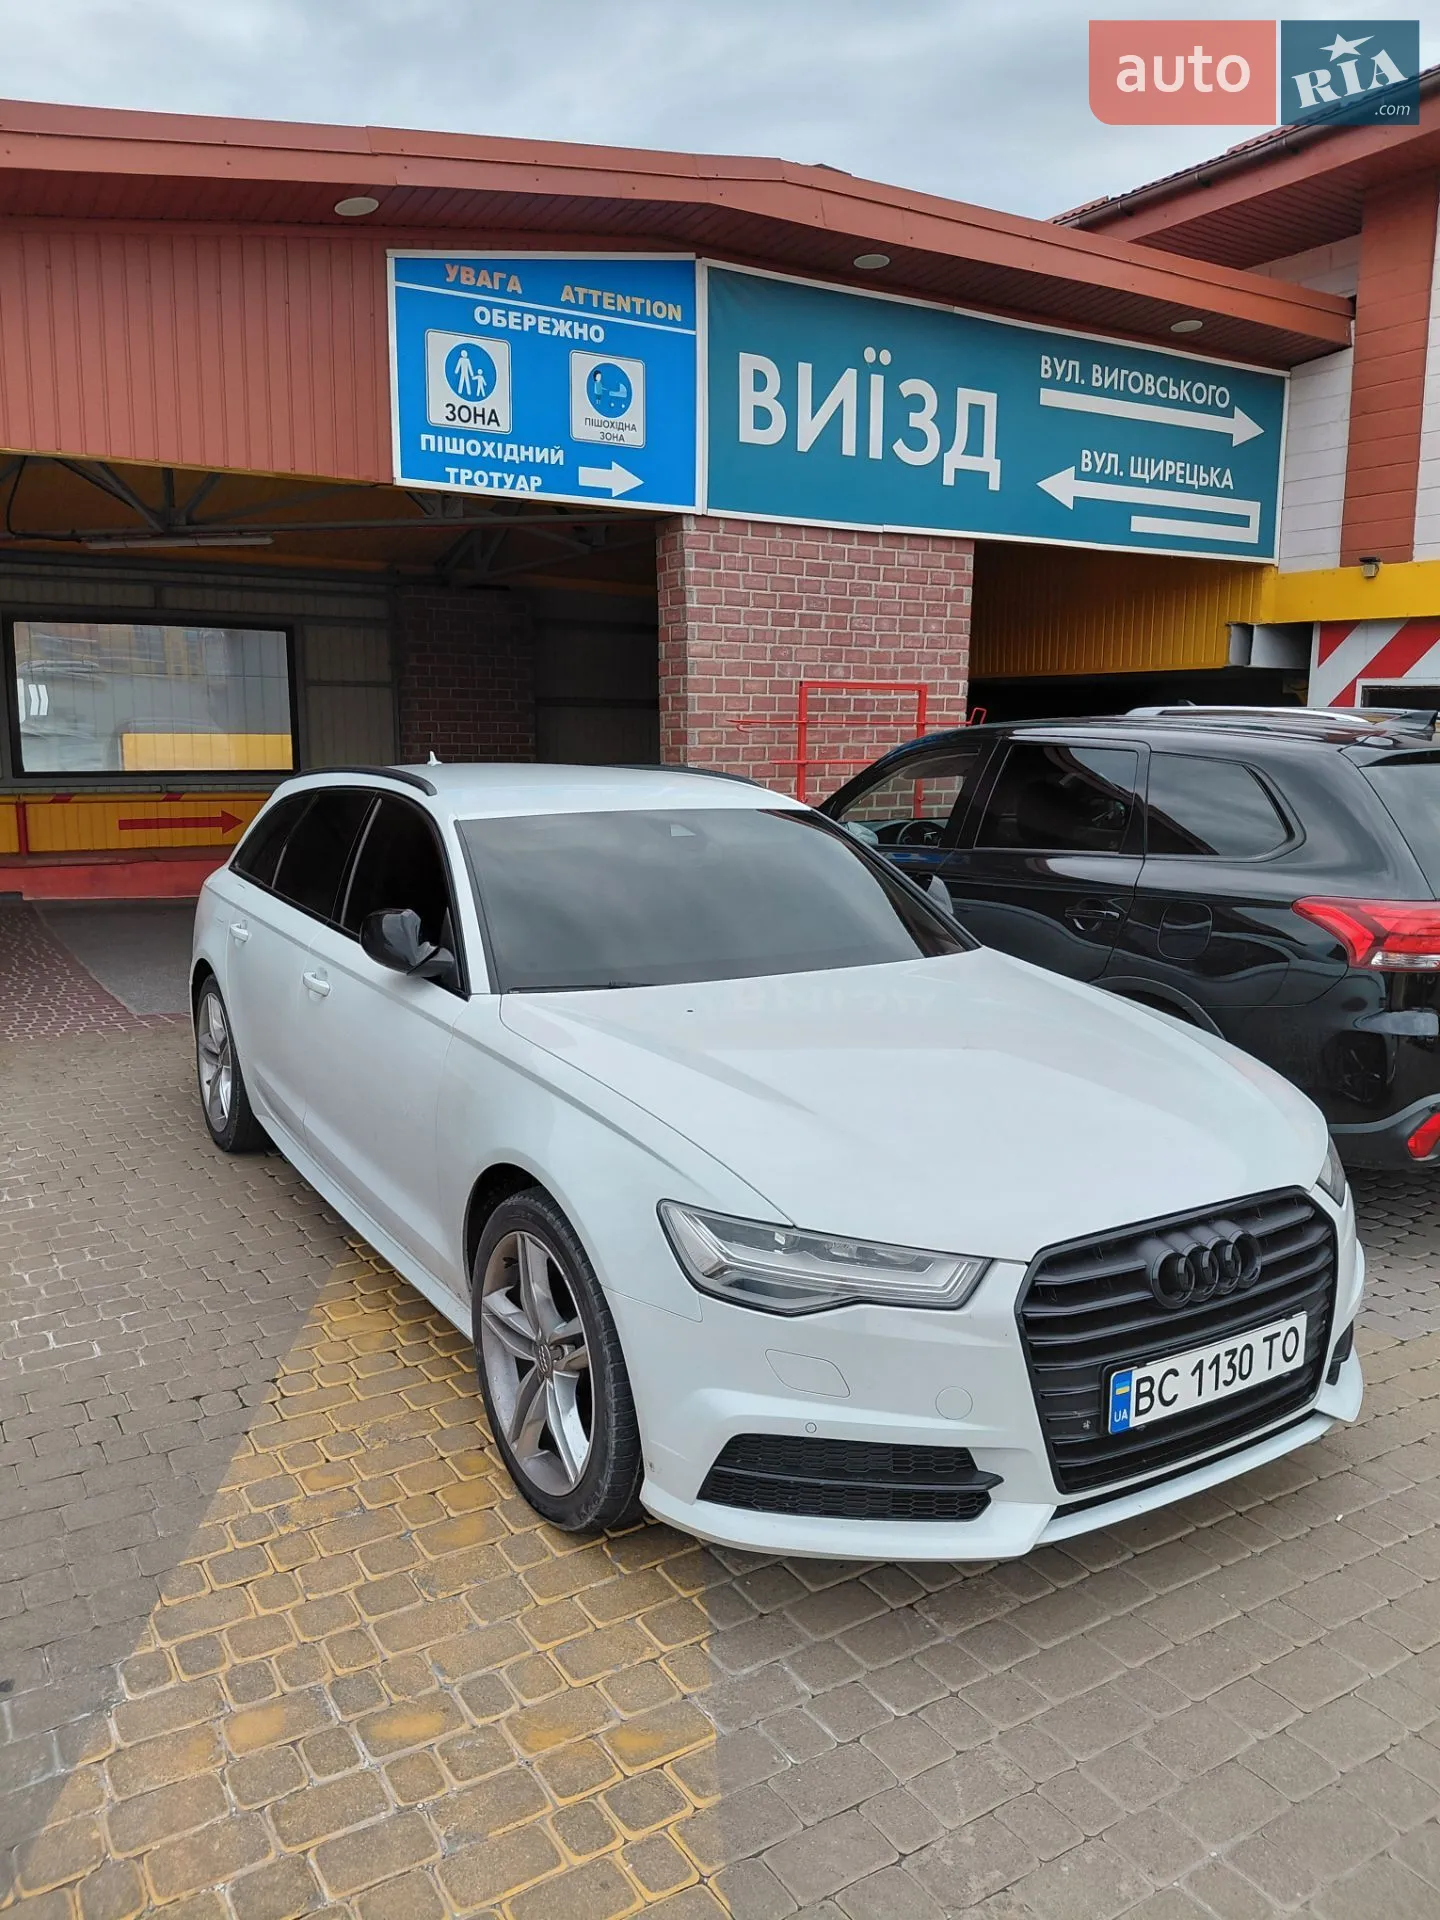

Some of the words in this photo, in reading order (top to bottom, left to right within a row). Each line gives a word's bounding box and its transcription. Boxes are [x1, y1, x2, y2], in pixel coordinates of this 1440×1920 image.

[445, 263, 523, 294] УВАГА
[560, 285, 682, 321] ATTENTION
[474, 306, 605, 343] ОБЕРЕЖНО
[1040, 354, 1085, 385] ВУЛ.
[1091, 363, 1231, 408] ВИГОВСЬКОГО
[444, 403, 501, 427] ЗОНА
[584, 417, 638, 433] ПІШОХІДНА
[739, 346, 1001, 491] ВИЇЗД
[420, 433, 565, 466] ПІШОХІДНИЙ
[599, 431, 626, 443] ЗОНА
[445, 467, 543, 493] ТРОТУАР
[1081, 449, 1124, 477] ВУЛ.
[1130, 456, 1234, 489] ЩИРЕЦЬКА
[1134, 1368, 1179, 1418] BC
[1191, 1343, 1254, 1397] 1130
[1262, 1326, 1300, 1371] TO
[1114, 1408, 1129, 1424] UA
